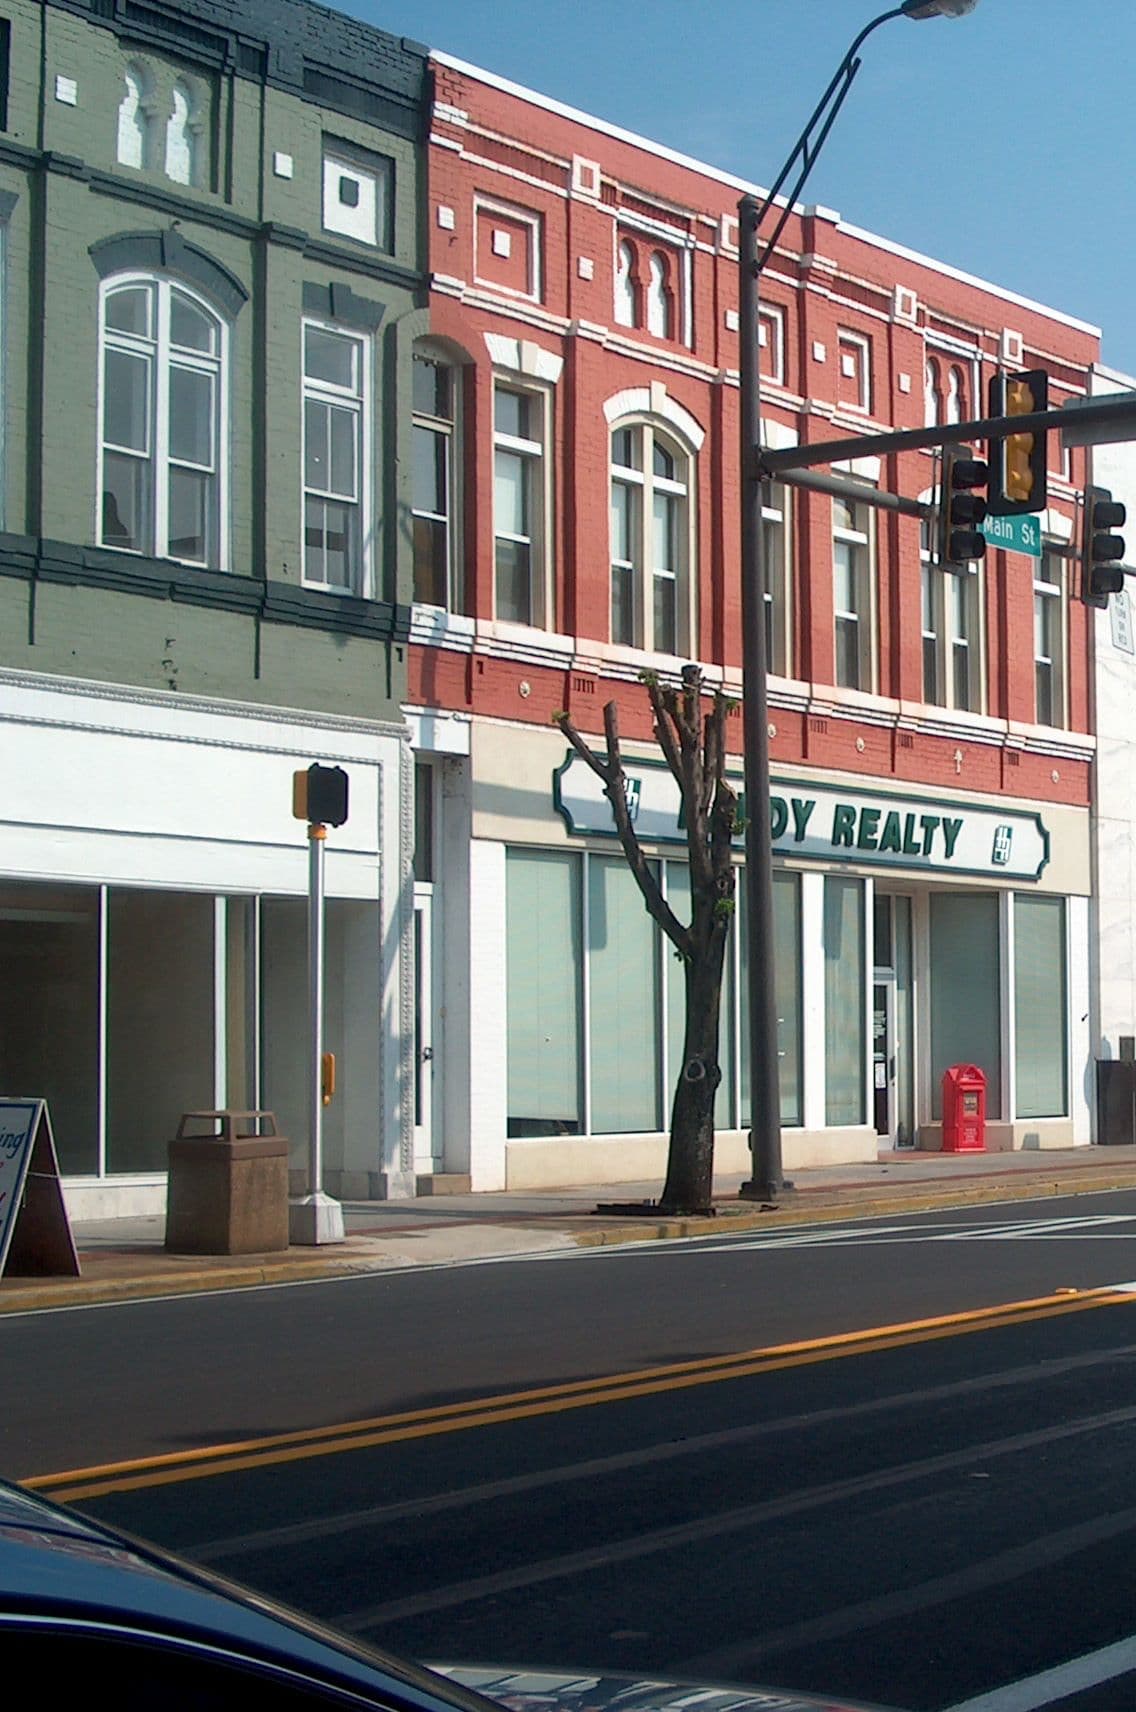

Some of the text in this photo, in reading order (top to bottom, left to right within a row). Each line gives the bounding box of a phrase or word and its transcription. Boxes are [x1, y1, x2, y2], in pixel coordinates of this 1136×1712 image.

[983, 516, 1035, 546] Main St
[831, 804, 964, 859] REALTY
[0, 1127, 27, 1158] ing
